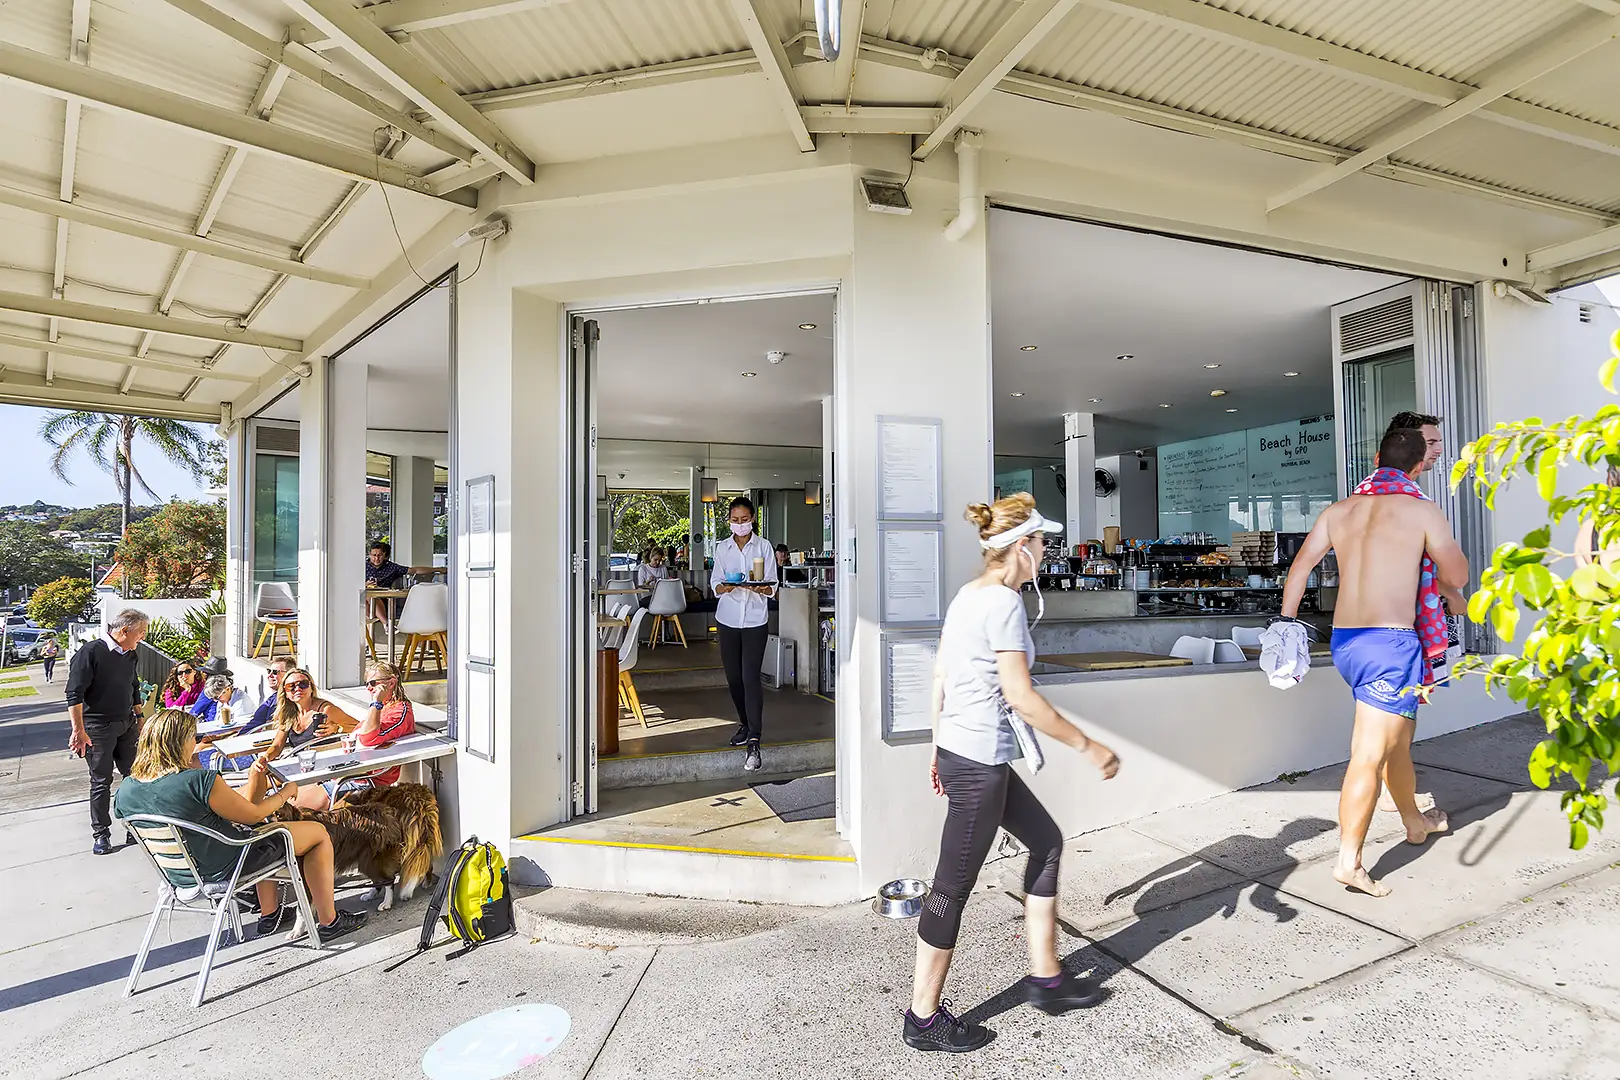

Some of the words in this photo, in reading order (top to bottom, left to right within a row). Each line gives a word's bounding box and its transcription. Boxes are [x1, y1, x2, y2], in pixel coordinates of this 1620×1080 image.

[1260, 434, 1291, 451] Beach
[1299, 430, 1330, 444] House
[1284, 449, 1292, 458] by
[1294, 446, 1308, 454] GPO
